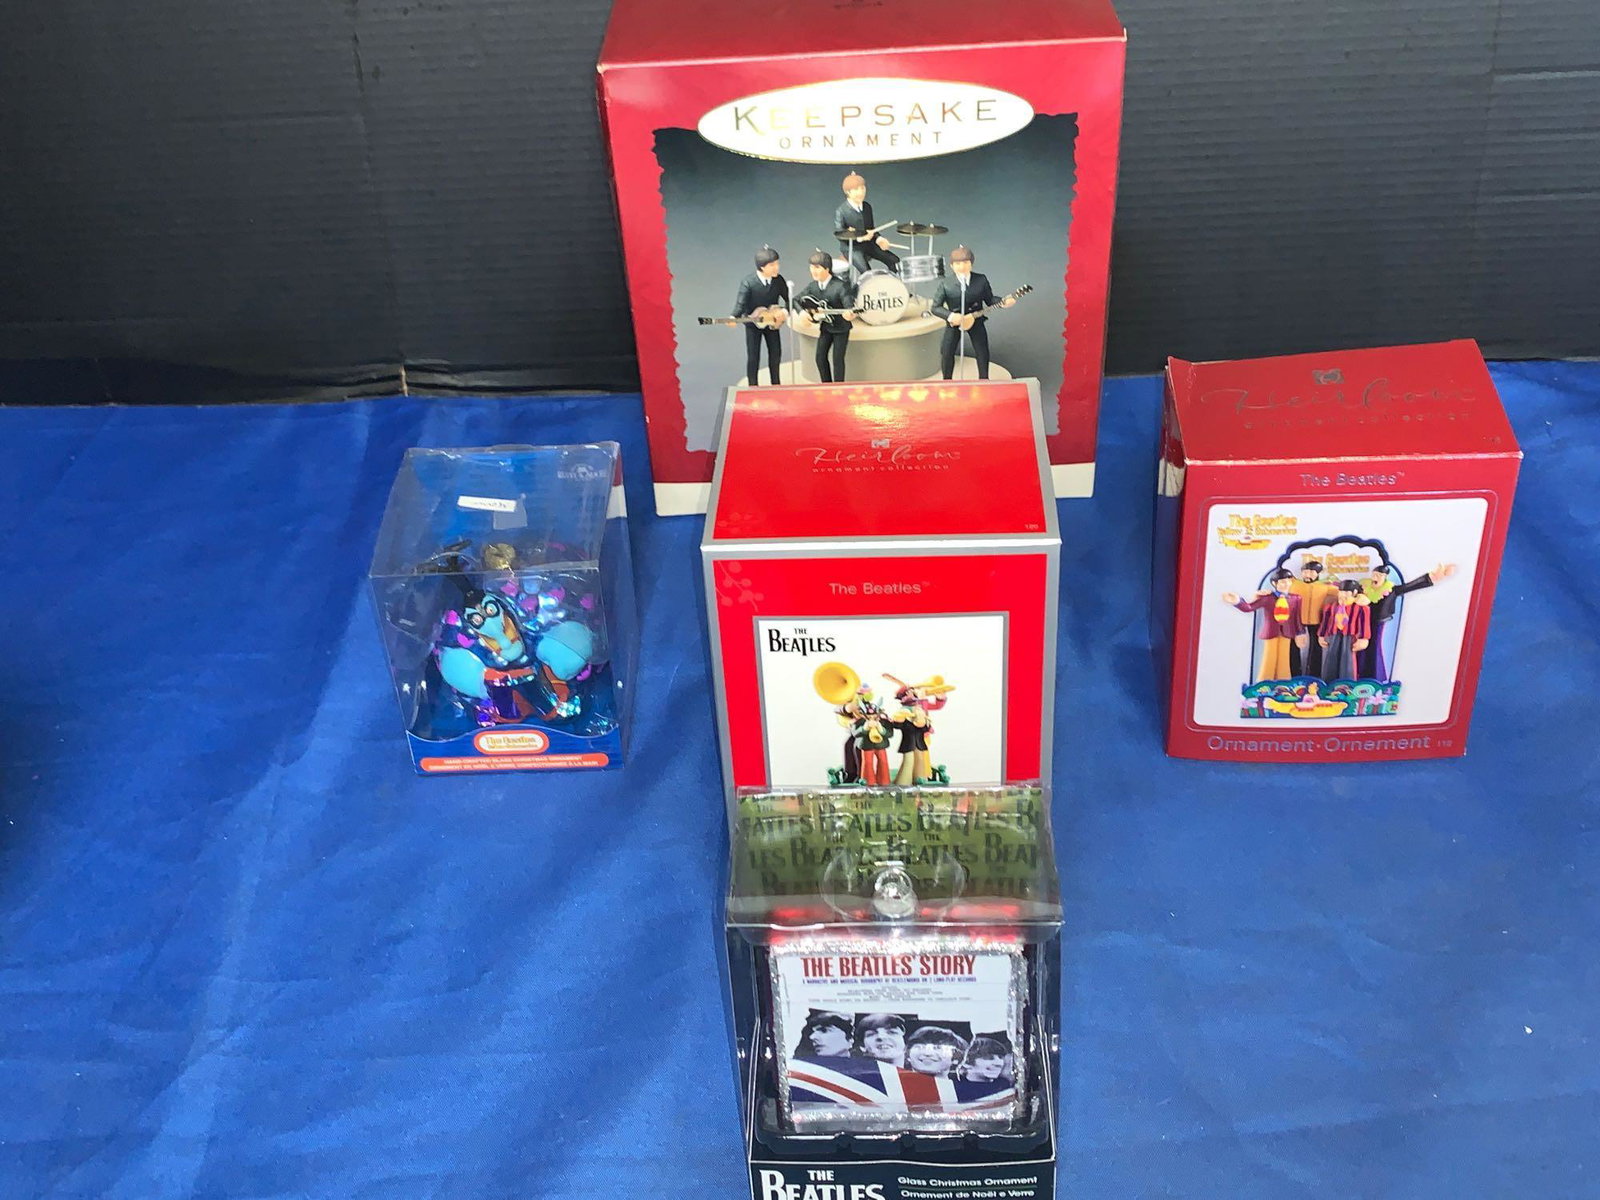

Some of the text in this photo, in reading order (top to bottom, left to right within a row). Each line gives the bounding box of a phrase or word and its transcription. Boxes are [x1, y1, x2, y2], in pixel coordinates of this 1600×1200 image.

[734, 99, 997, 135] KEEPSAKE
[779, 131, 942, 149] ORNAMENT
[863, 294, 904, 312] BEATLES
[1299, 474, 1331, 487] The
[829, 582, 857, 595] The
[768, 628, 836, 656] BEATLES
[801, 955, 833, 977] THE
[920, 954, 976, 976] STORY
[759, 1169, 886, 1200] BEATLES
[807, 1170, 835, 1181] THE
[898, 1176, 1038, 1187] Glass Christmas Ornament
[901, 1189, 953, 1199] Ornement
[956, 1189, 970, 1199] de
[972, 1189, 997, 1199] Noël
[1008, 1189, 1035, 1198] Verre
